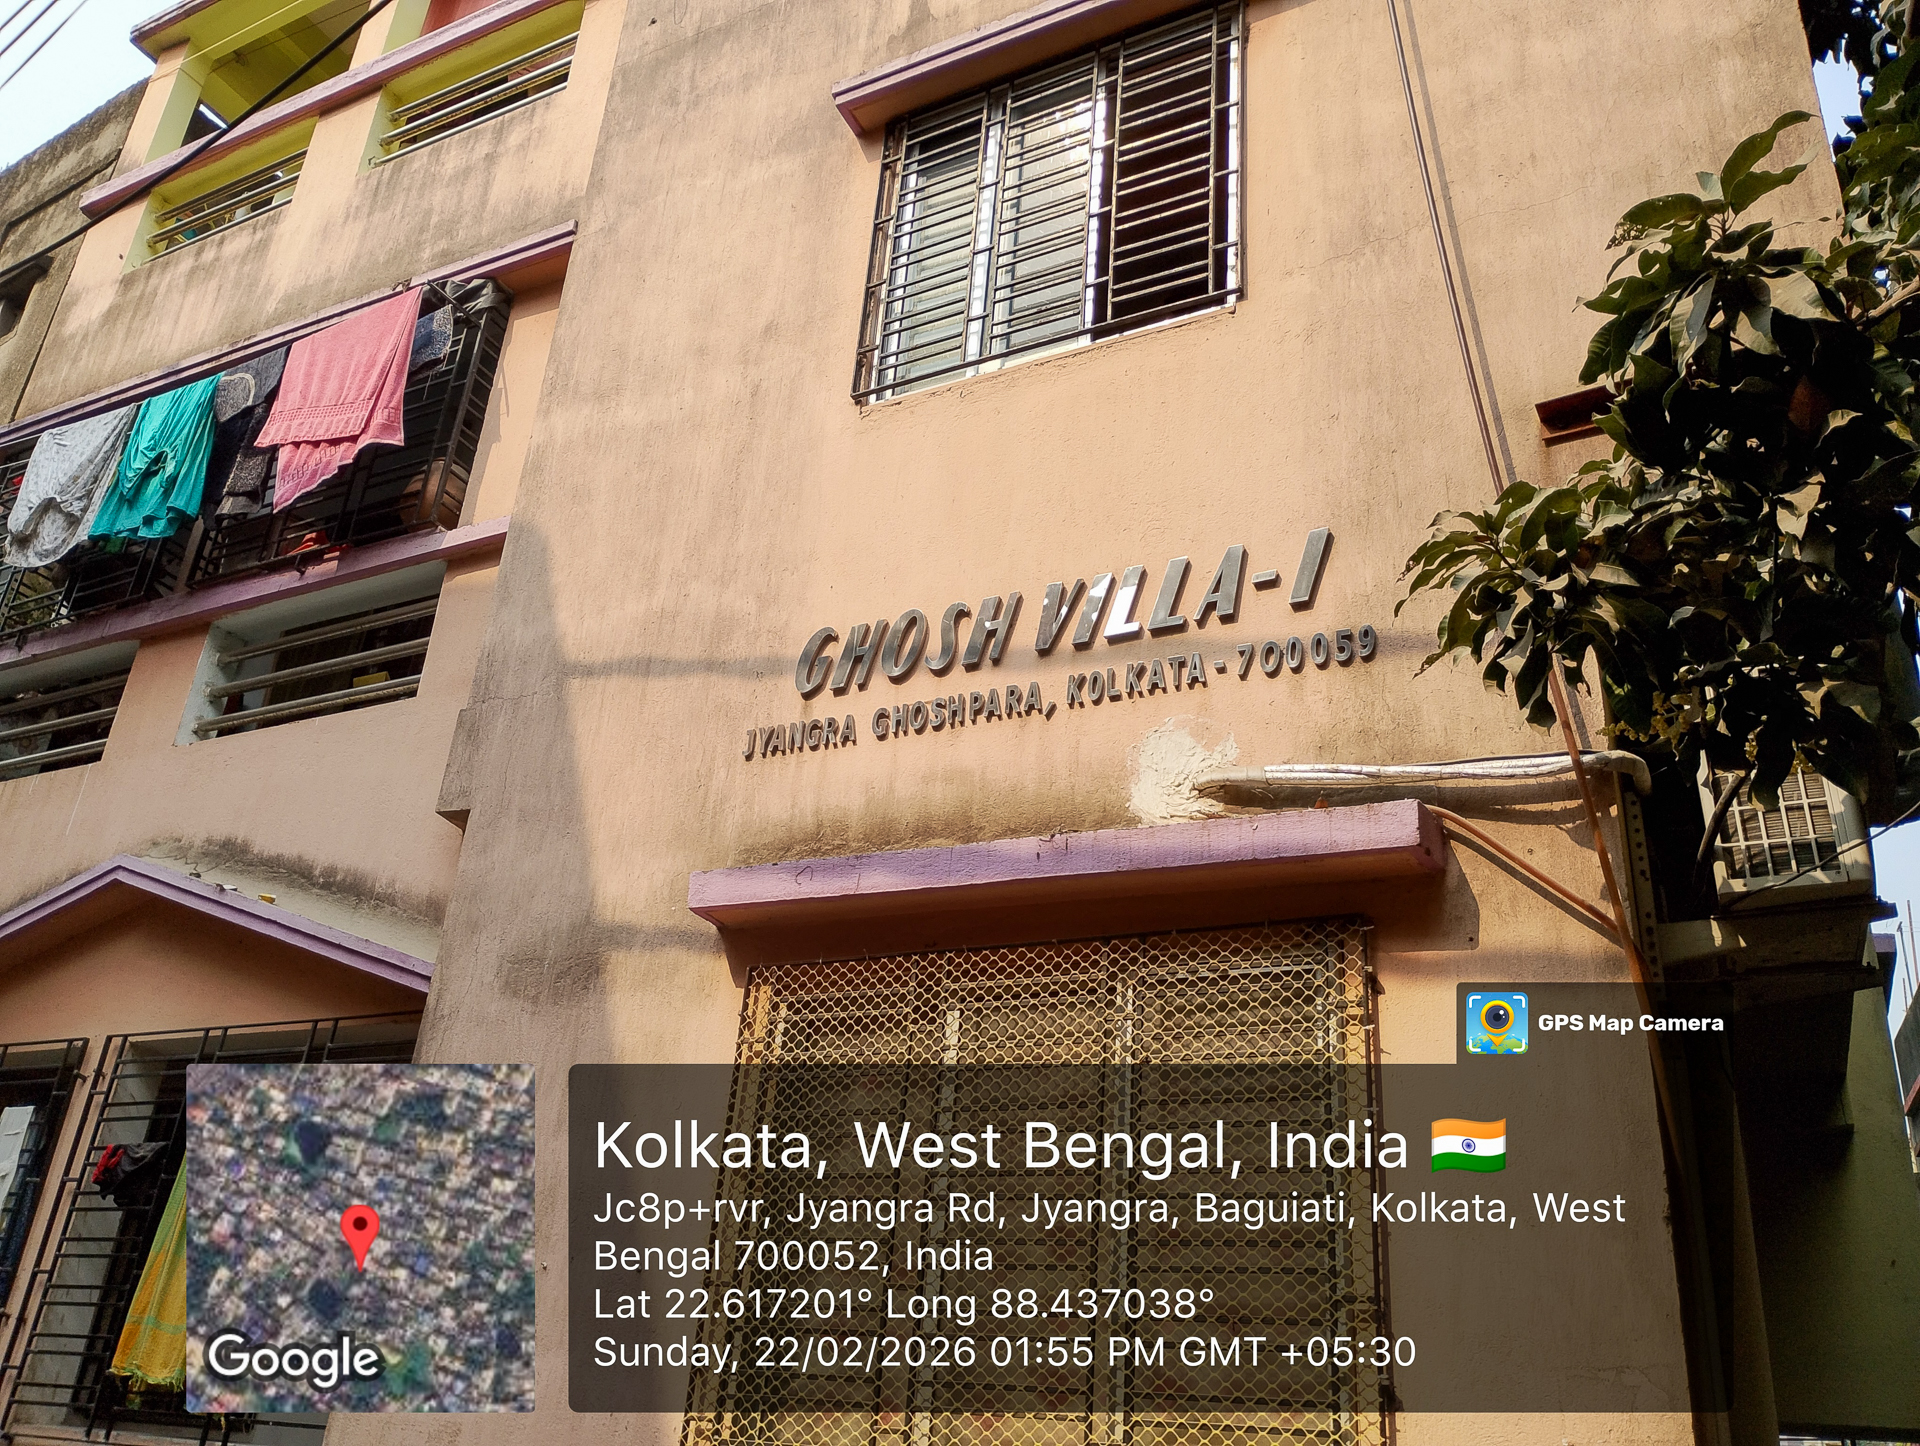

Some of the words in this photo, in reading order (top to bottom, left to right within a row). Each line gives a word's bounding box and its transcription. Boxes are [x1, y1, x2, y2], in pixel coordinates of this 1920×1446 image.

[795, 591, 1023, 694] GHOSH
[741, 714, 857, 760] JYANGRA
[871, 681, 1057, 741] GHOSHPARA,
